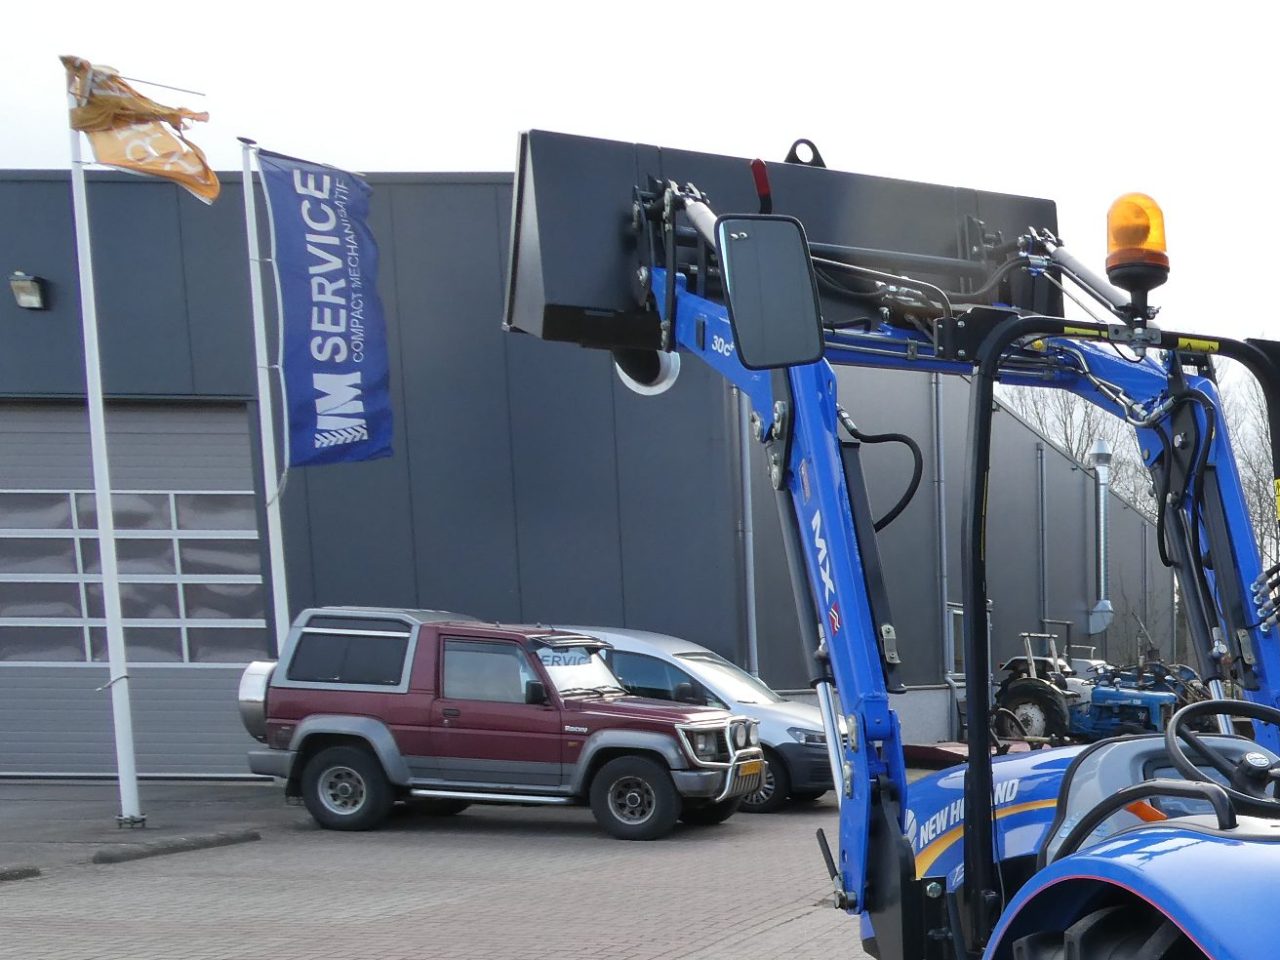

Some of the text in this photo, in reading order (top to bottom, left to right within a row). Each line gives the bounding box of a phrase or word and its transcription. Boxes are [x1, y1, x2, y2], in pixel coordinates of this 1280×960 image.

[293, 168, 348, 363] SERVICE
[351, 292, 365, 363] COMPACT
[811, 509, 836, 605] MX
[920, 806, 949, 849] NEW
